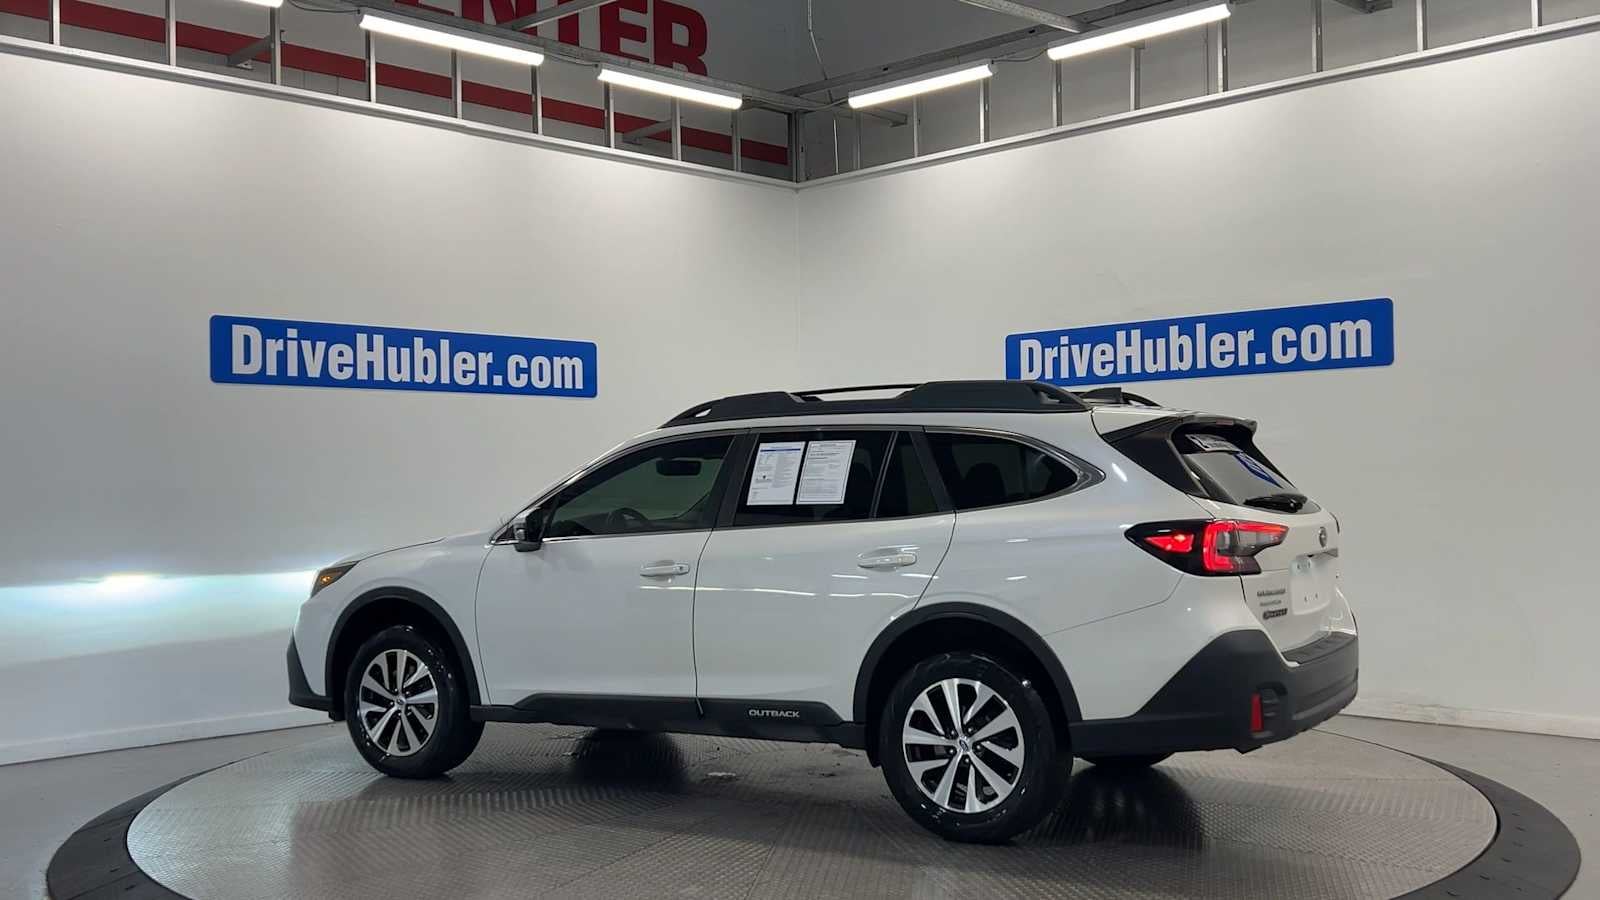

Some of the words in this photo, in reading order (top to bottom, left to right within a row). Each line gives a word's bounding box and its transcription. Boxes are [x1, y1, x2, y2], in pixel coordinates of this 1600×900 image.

[231, 324, 584, 390] DriveHubler.com
[1019, 318, 1373, 383] DriveHubler.com
[748, 709, 801, 718] OUTBACK
